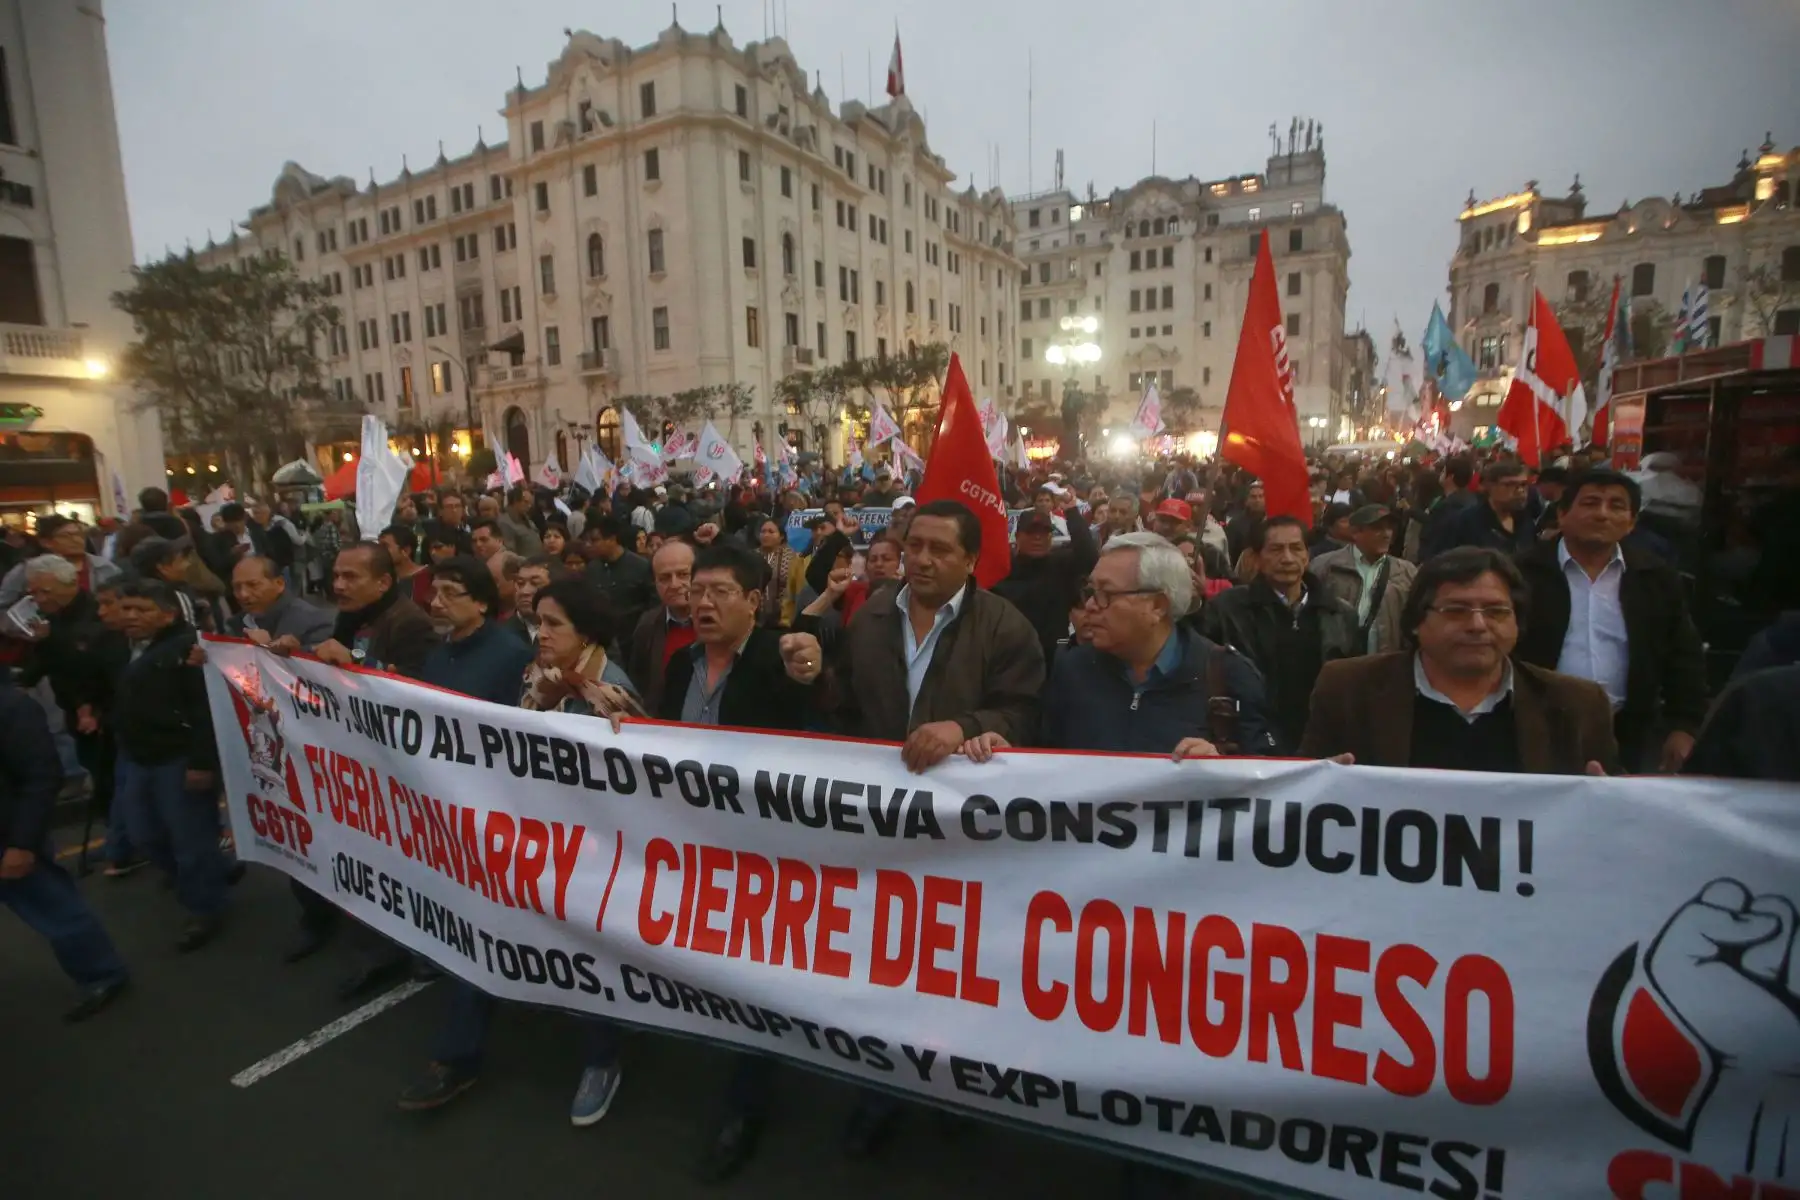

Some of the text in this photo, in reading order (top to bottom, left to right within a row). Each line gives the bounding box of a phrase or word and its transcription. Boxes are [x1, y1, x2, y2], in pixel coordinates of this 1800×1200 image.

[246, 793, 313, 858] CGTP
[304, 744, 392, 846] FUERA
[388, 776, 586, 921] CHAVARRY
[638, 837, 858, 979] CIERRE
[869, 869, 1000, 1008] DEL
[1021, 890, 1515, 1106] CONGRESO
[430, 715, 476, 766] AL
[478, 723, 637, 795] PUEBLO
[642, 753, 745, 814] POR
[754, 770, 946, 840] NUEVA
[960, 794, 1535, 897] CONSTITUCION!
[331, 852, 376, 903] ¡QUE
[378, 872, 406, 919] SE
[407, 886, 477, 964] VAYAN
[478, 928, 616, 1002] TODOS,
[620, 963, 895, 1072] CORRUPTOS
[901, 1044, 937, 1082] Y
[949, 1056, 1506, 1200] EXPLOTADORES!
